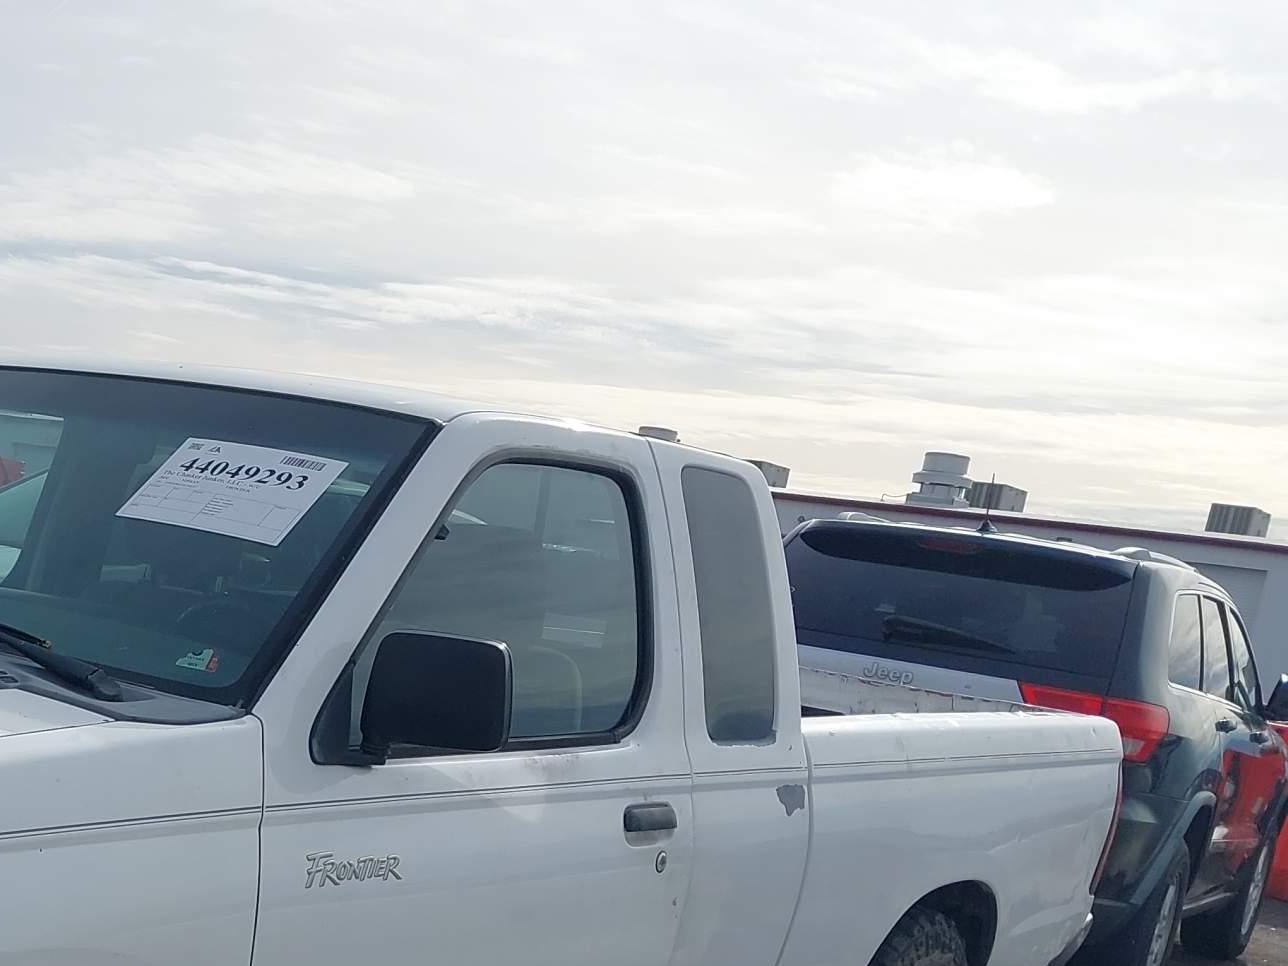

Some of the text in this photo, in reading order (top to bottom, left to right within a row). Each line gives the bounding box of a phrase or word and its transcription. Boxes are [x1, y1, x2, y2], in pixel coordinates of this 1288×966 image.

[179, 457, 311, 491] 44049293
[863, 661, 914, 686] Jeep
[304, 850, 404, 889] FRONTIER
